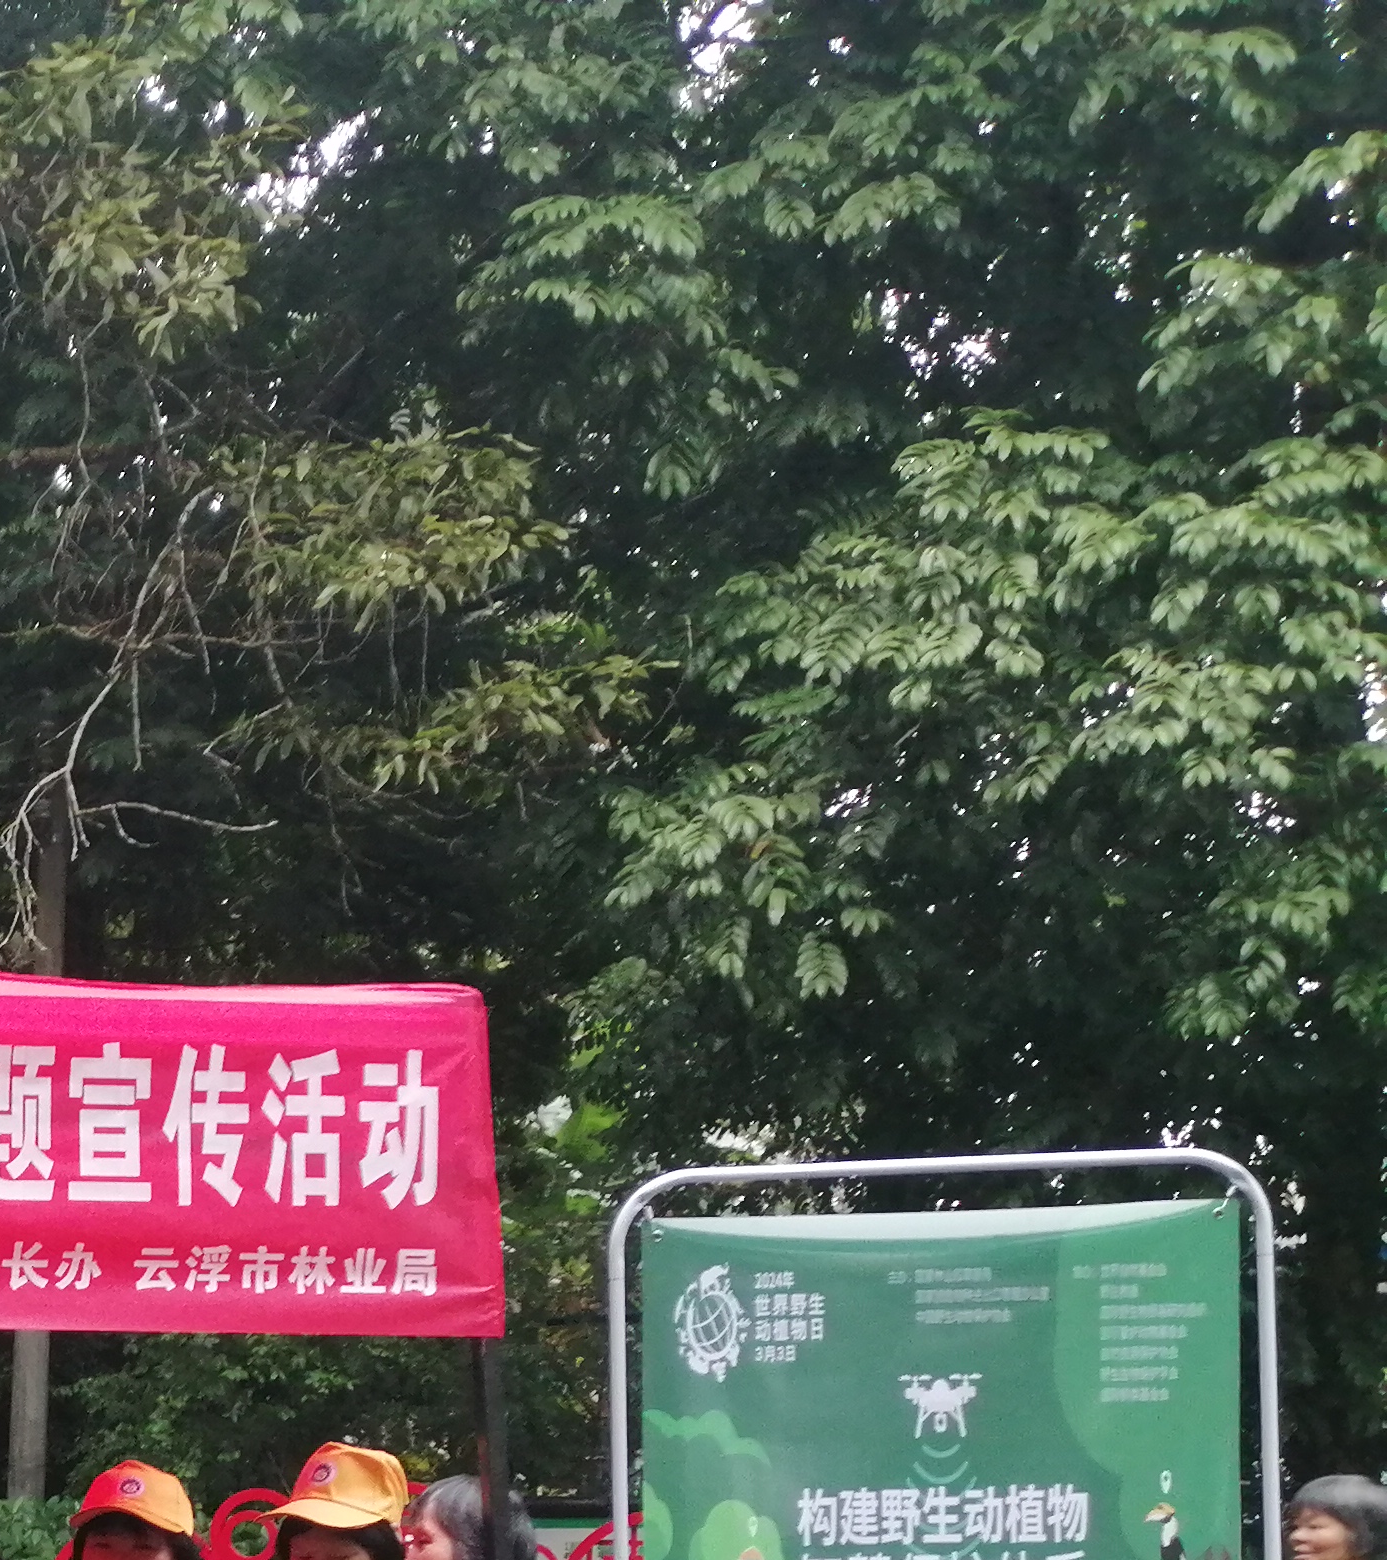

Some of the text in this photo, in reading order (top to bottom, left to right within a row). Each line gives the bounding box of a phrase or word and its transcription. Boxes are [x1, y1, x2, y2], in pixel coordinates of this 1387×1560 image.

[133, 1246, 438, 1297] 云浮市林业局
[797, 1484, 1090, 1547] 构建野生动植物
